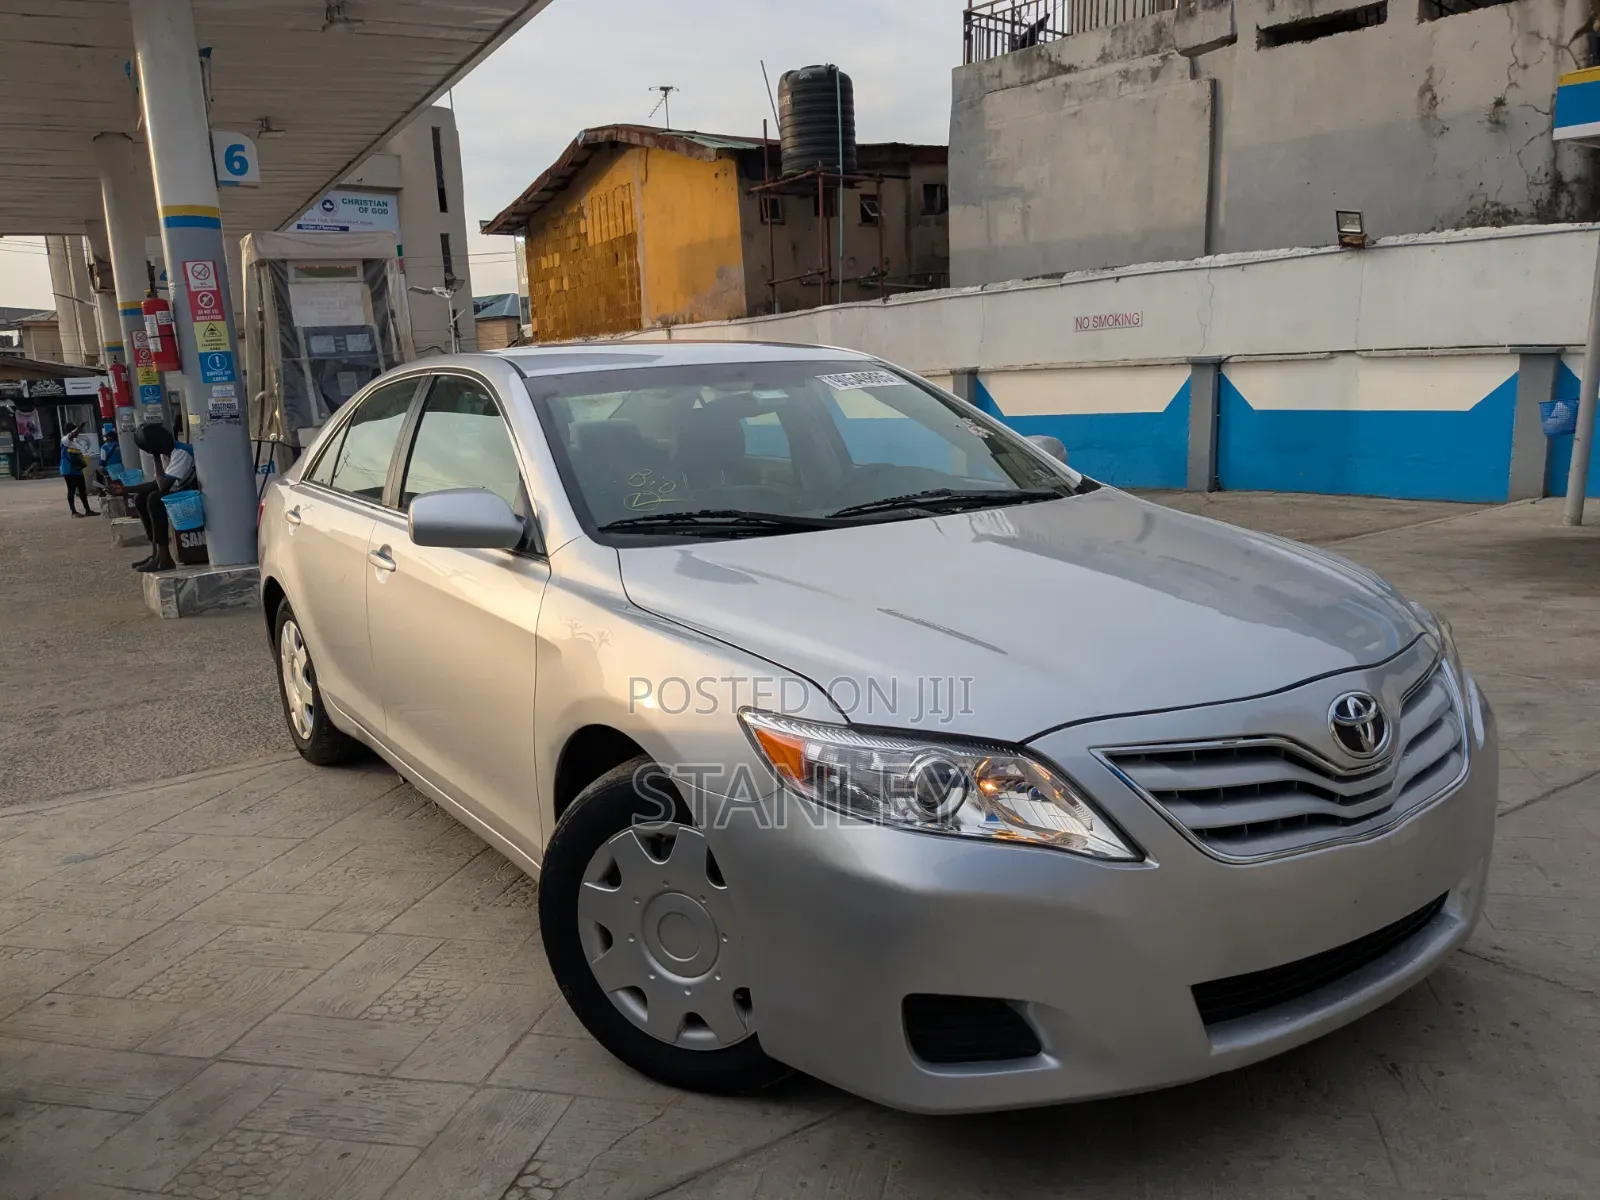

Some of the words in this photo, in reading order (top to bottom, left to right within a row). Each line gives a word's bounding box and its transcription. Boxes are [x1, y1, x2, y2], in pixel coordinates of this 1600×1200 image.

[224, 144, 249, 177] 6
[341, 197, 388, 208] CHRISTIAN
[358, 206, 369, 214] OF
[371, 207, 389, 215] GOD
[1075, 316, 1090, 330] NO
[1092, 312, 1140, 328] SMOKING
